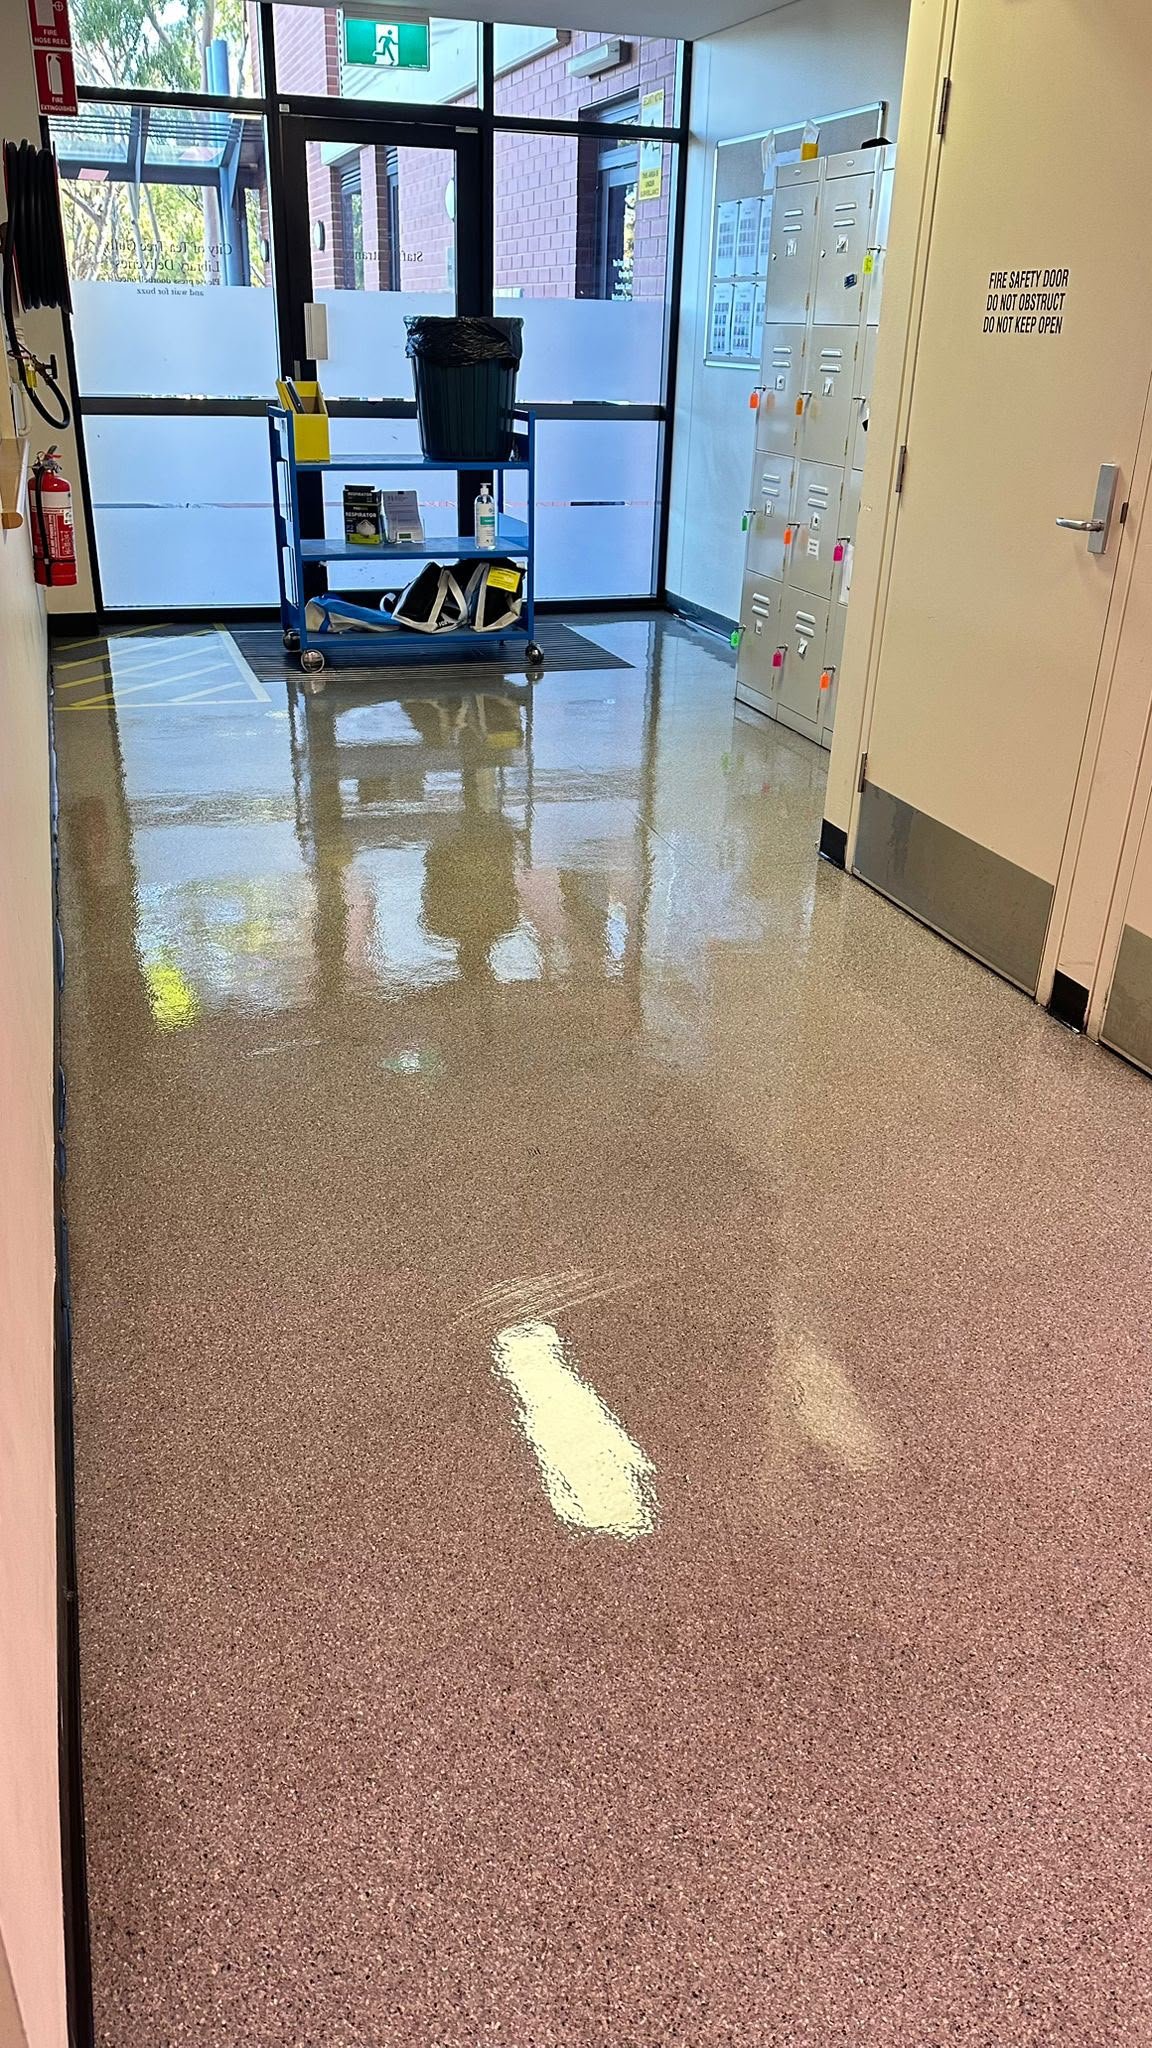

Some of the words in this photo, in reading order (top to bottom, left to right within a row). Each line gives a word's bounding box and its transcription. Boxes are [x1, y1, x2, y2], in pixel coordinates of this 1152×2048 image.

[40, 104, 76, 112] EXTINGUISHER
[989, 272, 1008, 289] FIRE
[1009, 270, 1042, 288] SAFETY
[1043, 269, 1069, 287] DOOR
[986, 294, 998, 311] DO
[1000, 293, 1018, 311] NOT
[1018, 292, 1066, 311] OBSTRUCT
[983, 316, 995, 333] DO
[996, 316, 1014, 333] NOT
[1014, 316, 1037, 333] KEEP
[1038, 316, 1063, 334] OPEN
